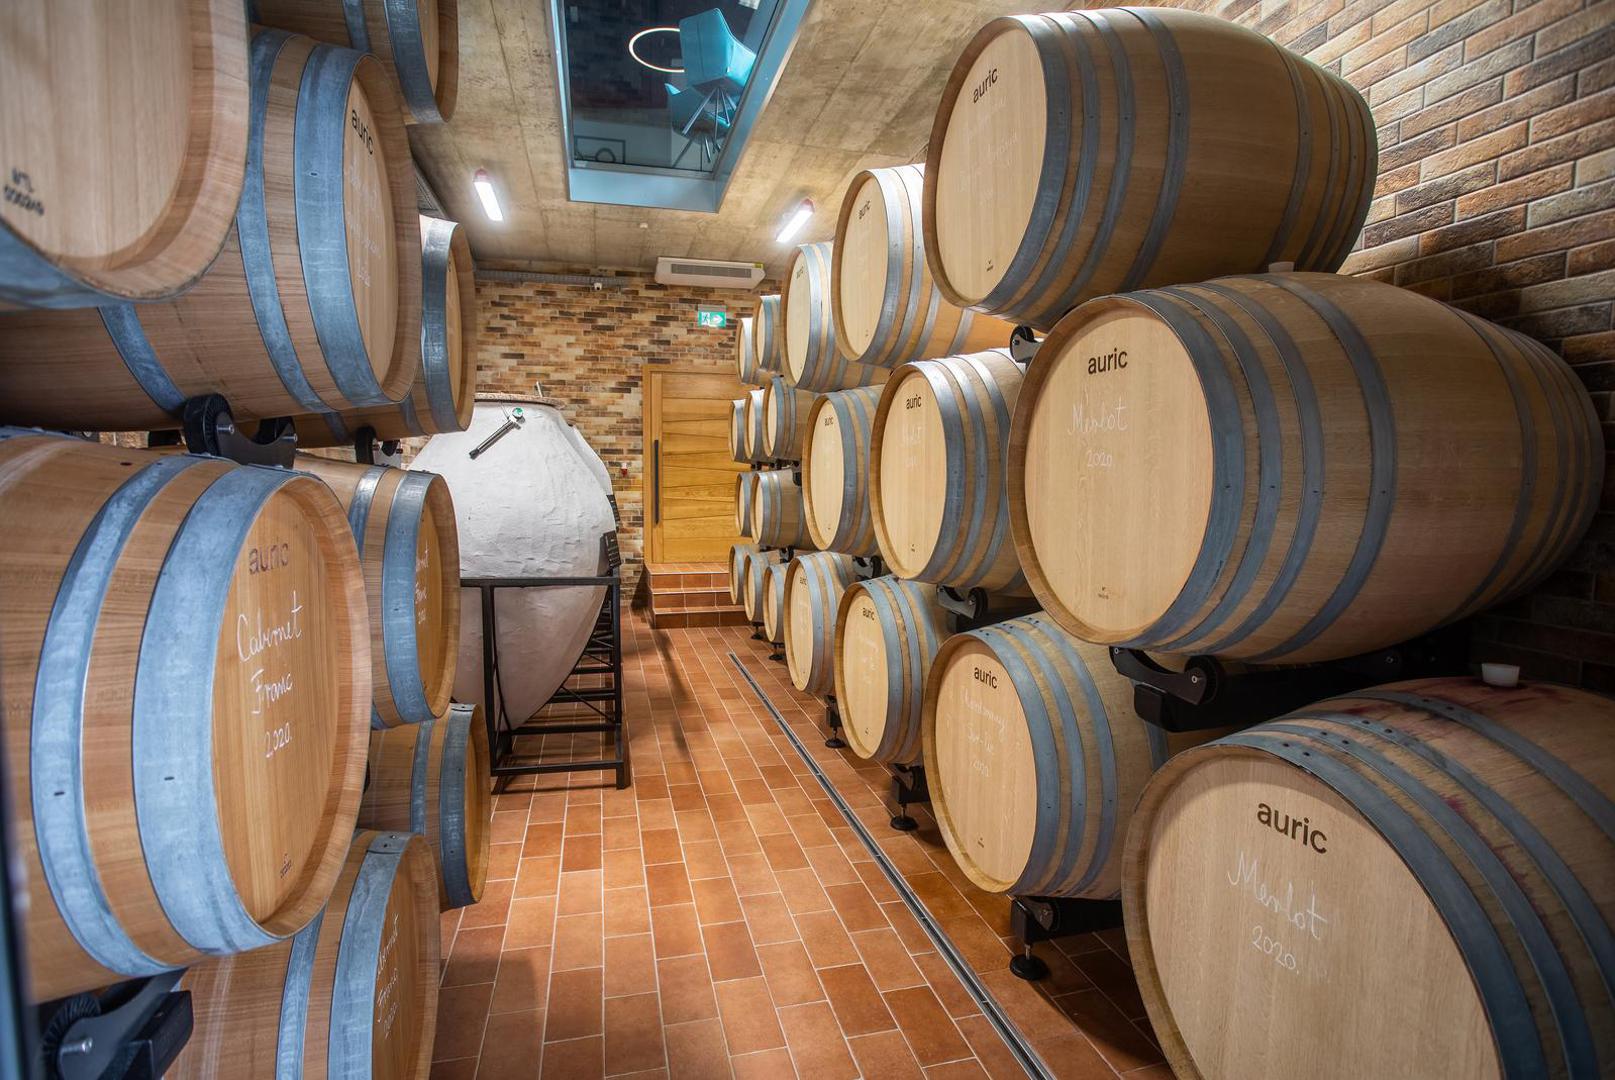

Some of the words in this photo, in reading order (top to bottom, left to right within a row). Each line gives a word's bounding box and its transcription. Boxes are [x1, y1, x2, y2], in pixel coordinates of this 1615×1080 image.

[973, 68, 999, 104] auric
[352, 109, 374, 155] auric
[1088, 347, 1128, 375] auric
[906, 394, 922, 410] auric
[249, 536, 289, 576] auric
[251, 668, 293, 715] Franc
[973, 666, 998, 690] auric
[1257, 803, 1328, 854] auric
[1227, 850, 1328, 942] Merlot
